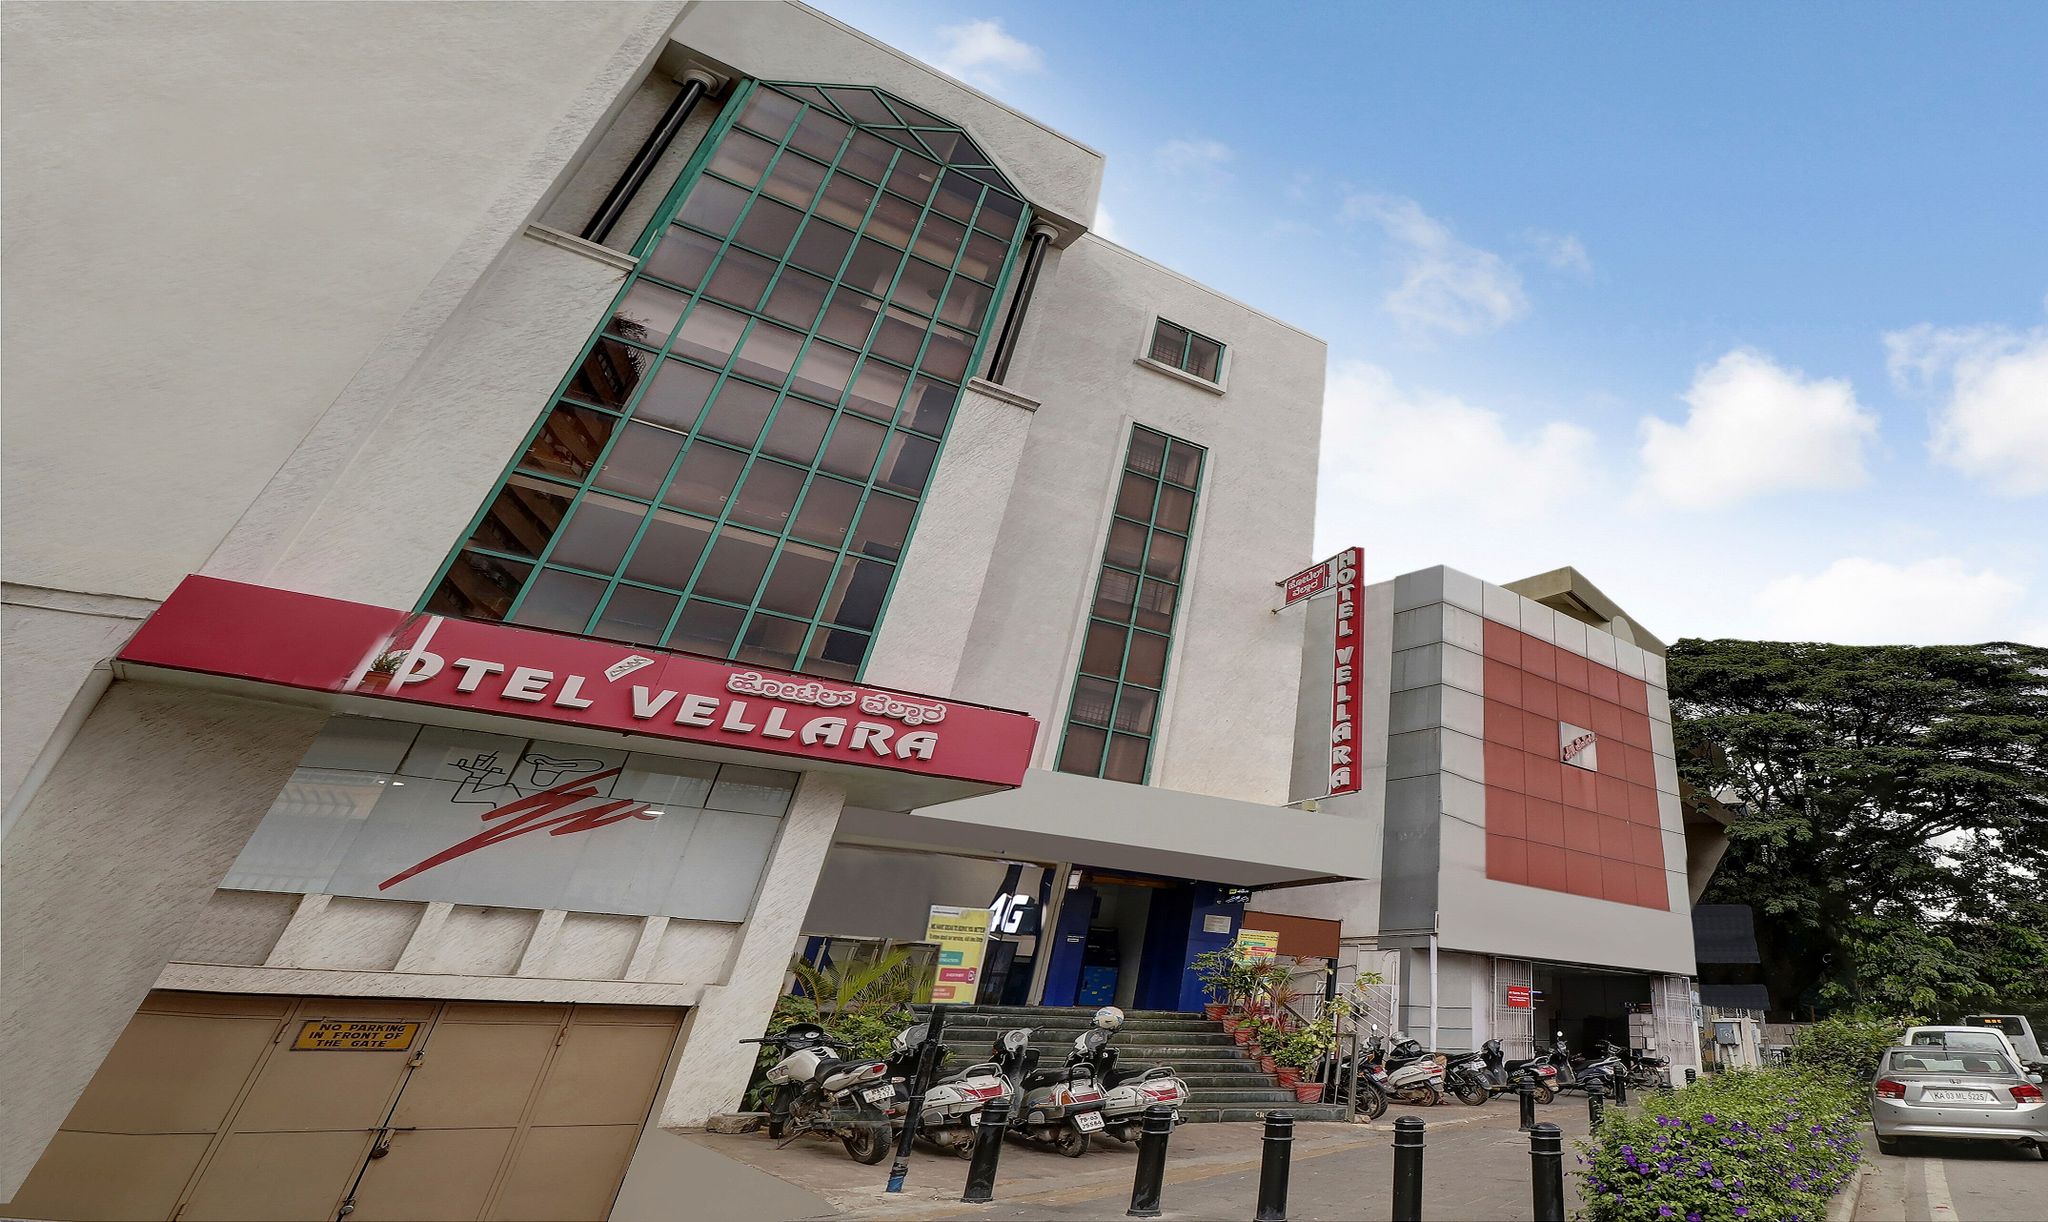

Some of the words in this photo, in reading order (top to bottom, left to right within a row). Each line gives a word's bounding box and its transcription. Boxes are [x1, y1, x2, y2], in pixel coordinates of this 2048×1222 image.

[1337, 549, 1357, 637] HOTEL
[1331, 645, 1354, 789] VELLARA
[631, 685, 939, 761] VELLARA
[319, 1023, 342, 1032] NO
[349, 1024, 406, 1032] PARKING
[309, 1031, 324, 1039] IN
[333, 1032, 380, 1040] FRONT
[384, 1032, 404, 1040] OF
[351, 1040, 387, 1048] GATE
[1934, 1092, 1945, 1100] KA
[1968, 1093, 1984, 1101] 5225
